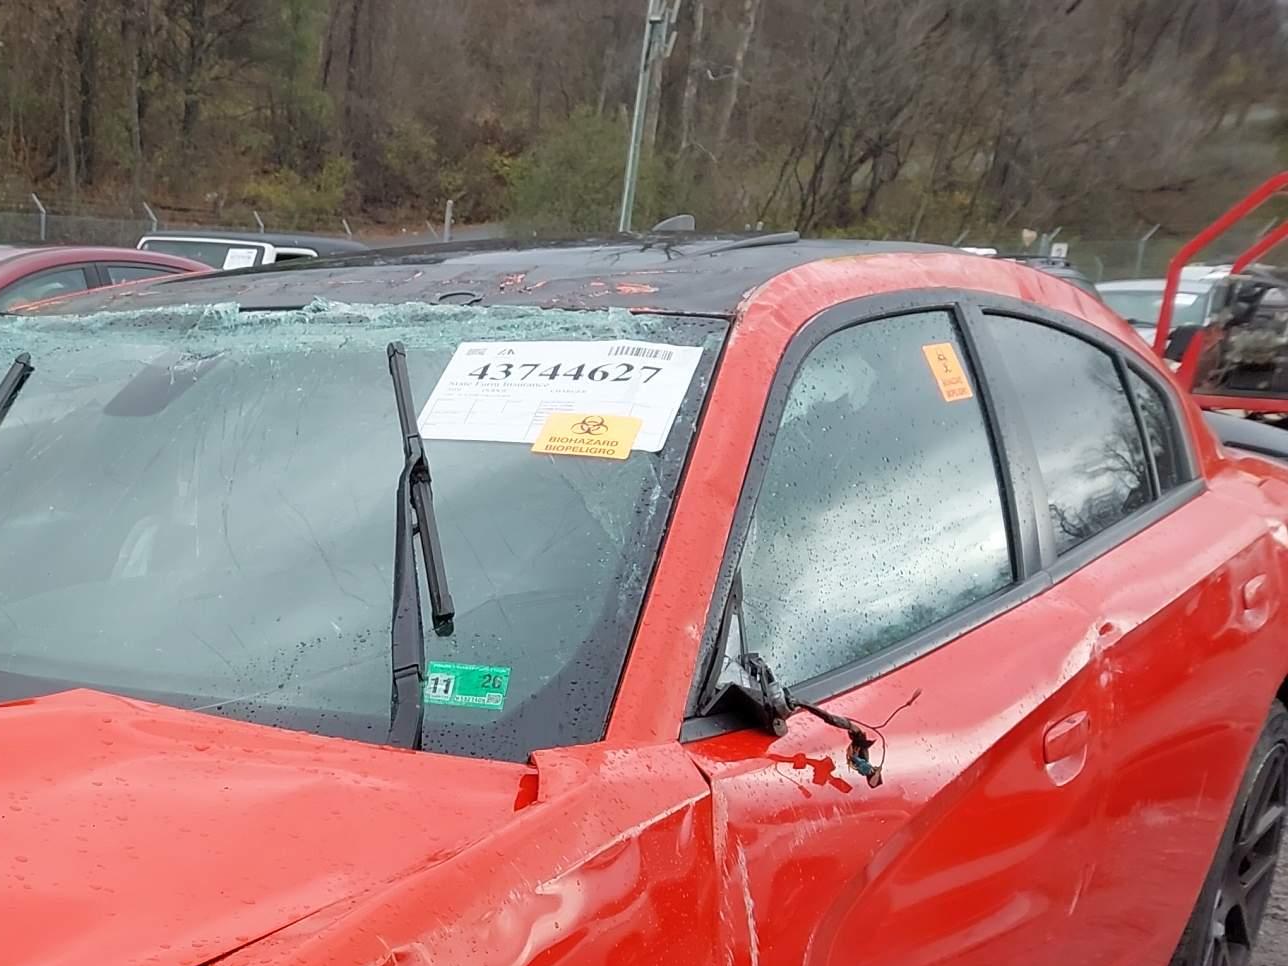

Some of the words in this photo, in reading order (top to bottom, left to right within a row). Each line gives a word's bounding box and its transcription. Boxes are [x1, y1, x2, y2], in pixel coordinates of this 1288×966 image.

[468, 362, 662, 383] 43744627
[548, 436, 619, 447] BIOHAZARD
[544, 444, 615, 456] BIOPELIGRO
[431, 677, 451, 694] 11
